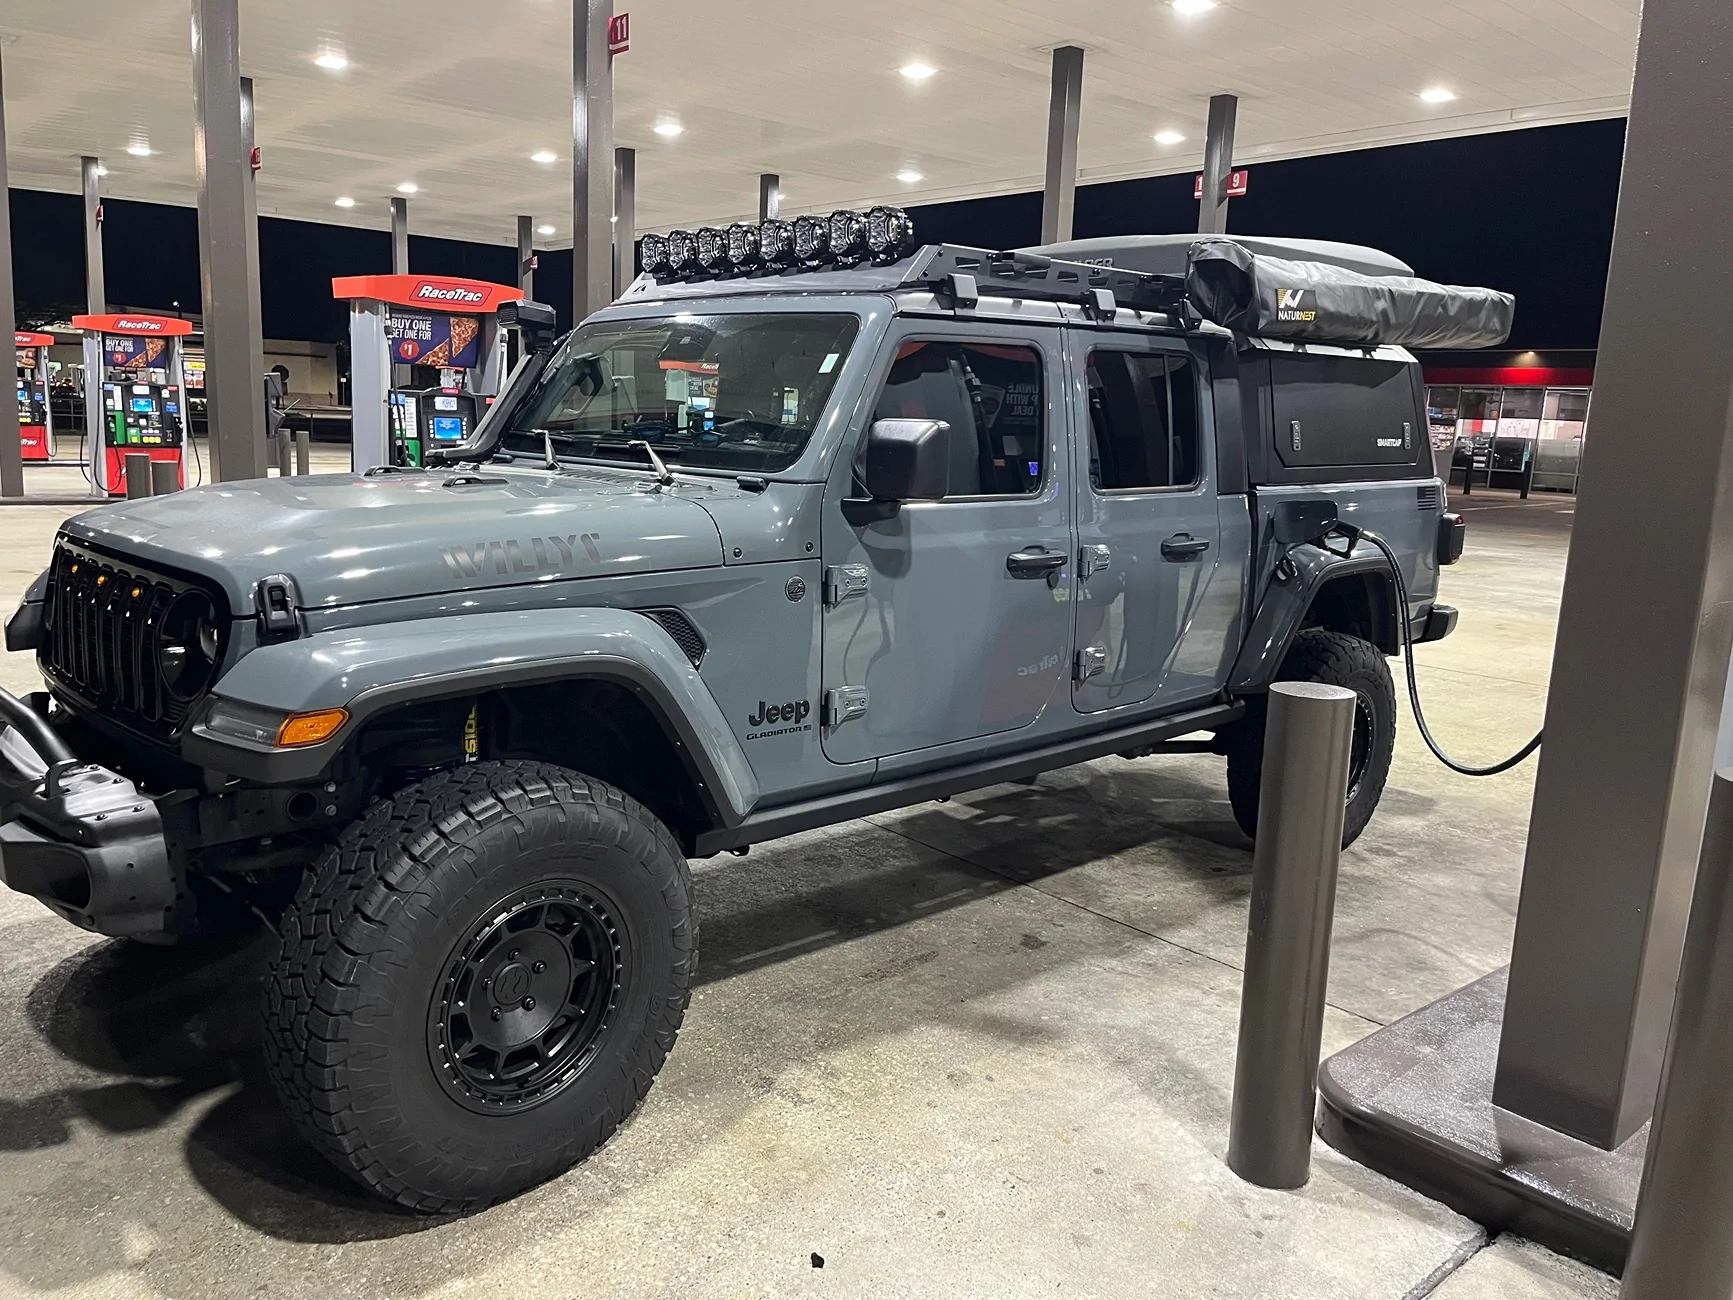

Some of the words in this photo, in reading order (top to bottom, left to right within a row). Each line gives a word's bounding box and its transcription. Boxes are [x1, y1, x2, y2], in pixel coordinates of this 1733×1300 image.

[616, 16, 627, 40] 11
[1197, 176, 1203, 191] 1
[1232, 173, 1240, 188] 9
[418, 285, 483, 302] RaceTrac
[1278, 310, 1316, 322] NATURNEST
[118, 320, 161, 330] RaceTrac
[391, 318, 411, 328] BUY
[412, 320, 432, 331] ONE
[404, 329, 418, 340] ONE
[419, 331, 432, 340] FOR
[404, 343, 413, 356] $1
[439, 532, 602, 579] WILLYS
[748, 699, 810, 727] Jeep
[746, 725, 802, 740] GLADIATOR
